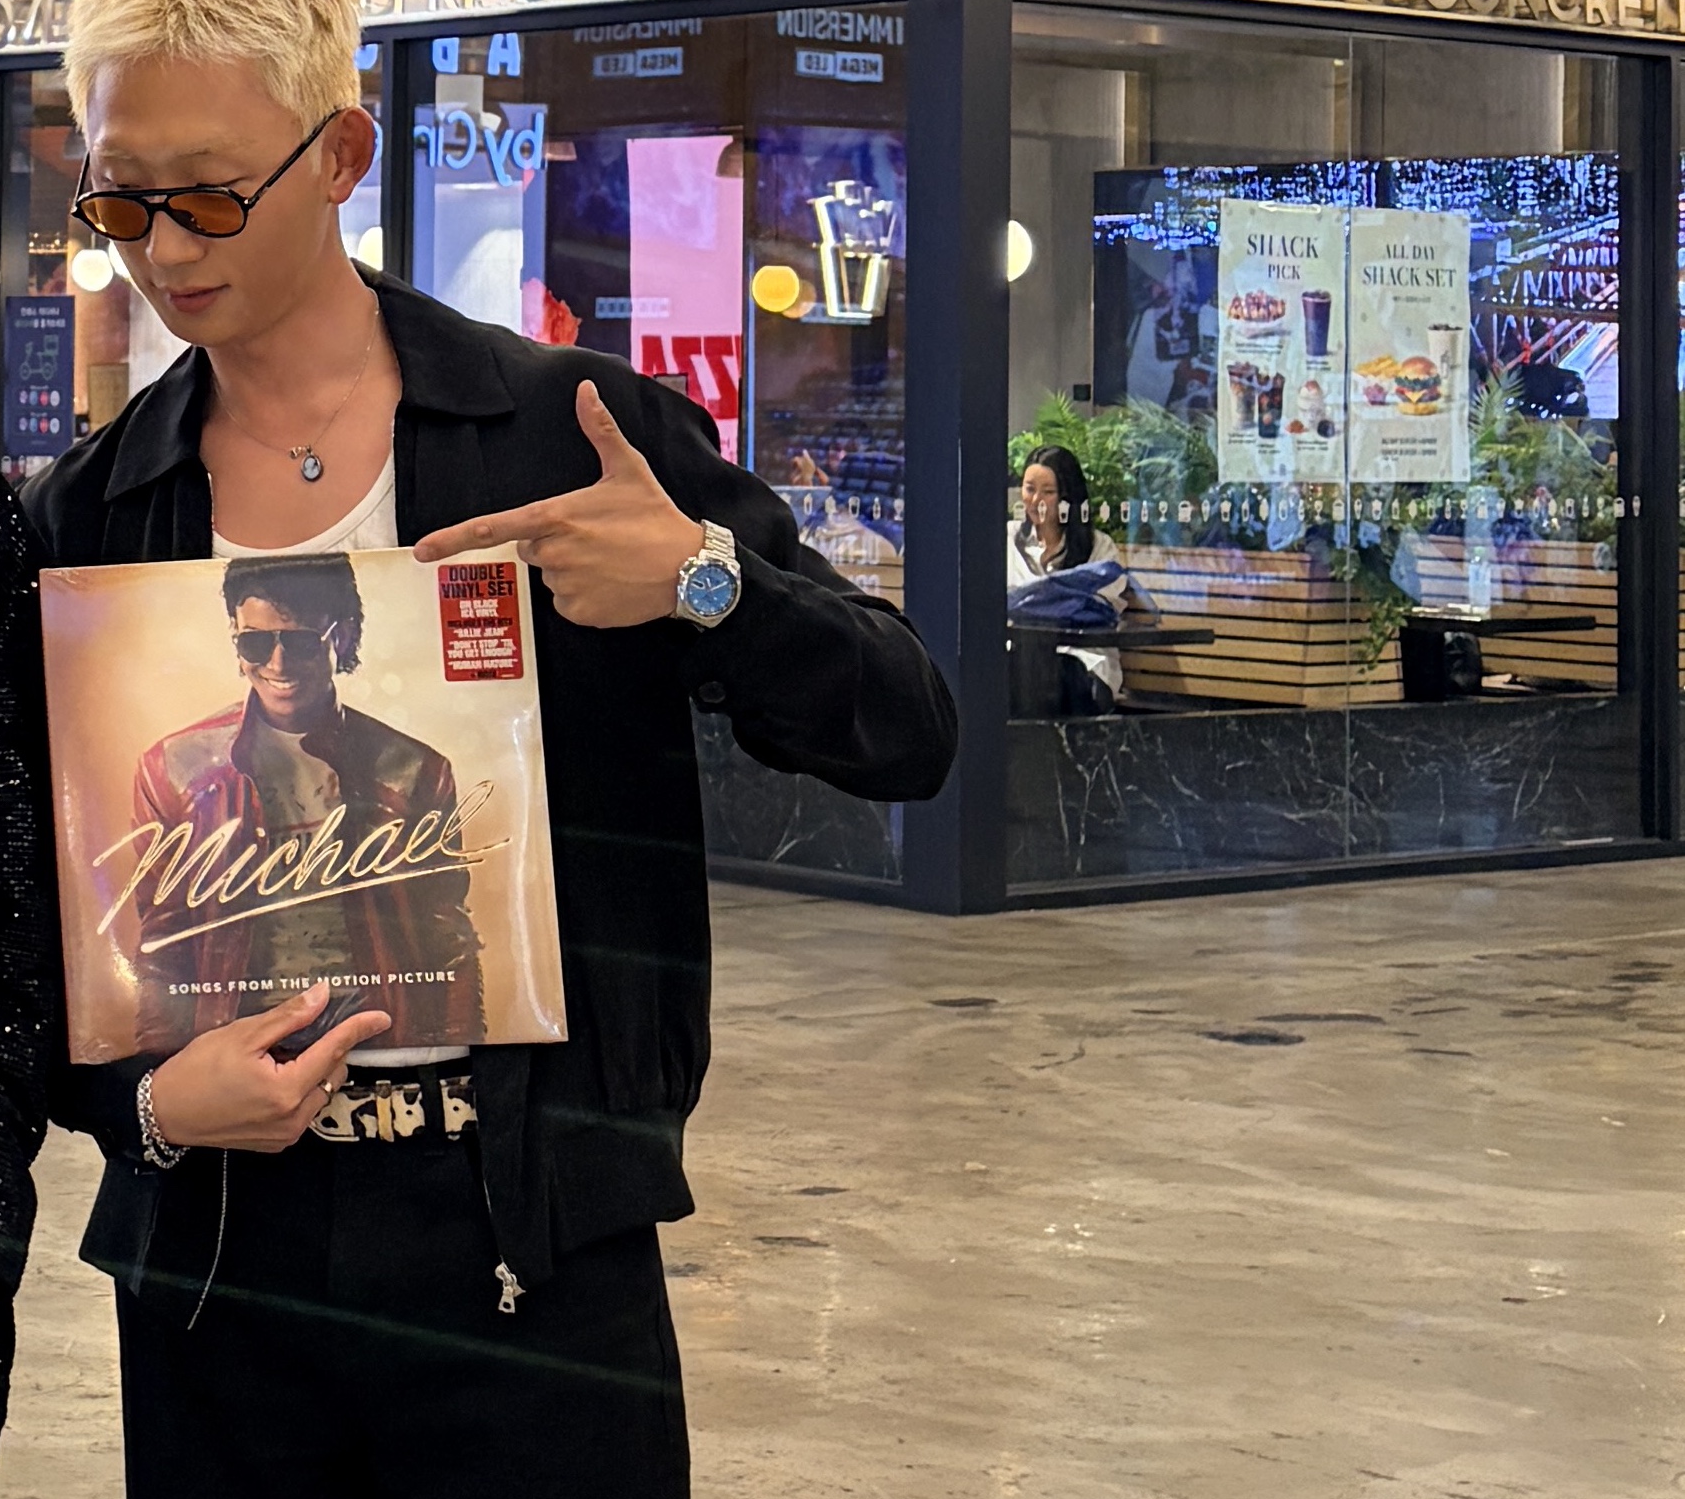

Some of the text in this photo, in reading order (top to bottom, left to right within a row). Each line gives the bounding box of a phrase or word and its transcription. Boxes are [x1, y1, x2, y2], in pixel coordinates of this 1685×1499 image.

[1246, 233, 1320, 260] SHACK
[1384, 243, 1439, 261] ALL DAY
[1267, 262, 1302, 281] PICK
[1362, 265, 1458, 289] SHACK SET
[449, 564, 505, 582] DOUBLE
[441, 580, 515, 599] VINYL SET
[93, 779, 513, 935] Michael
[168, 982, 223, 995] SONGS
[228, 979, 274, 992] FROM
[280, 977, 310, 990] THE
[387, 970, 456, 984] PICTURE
